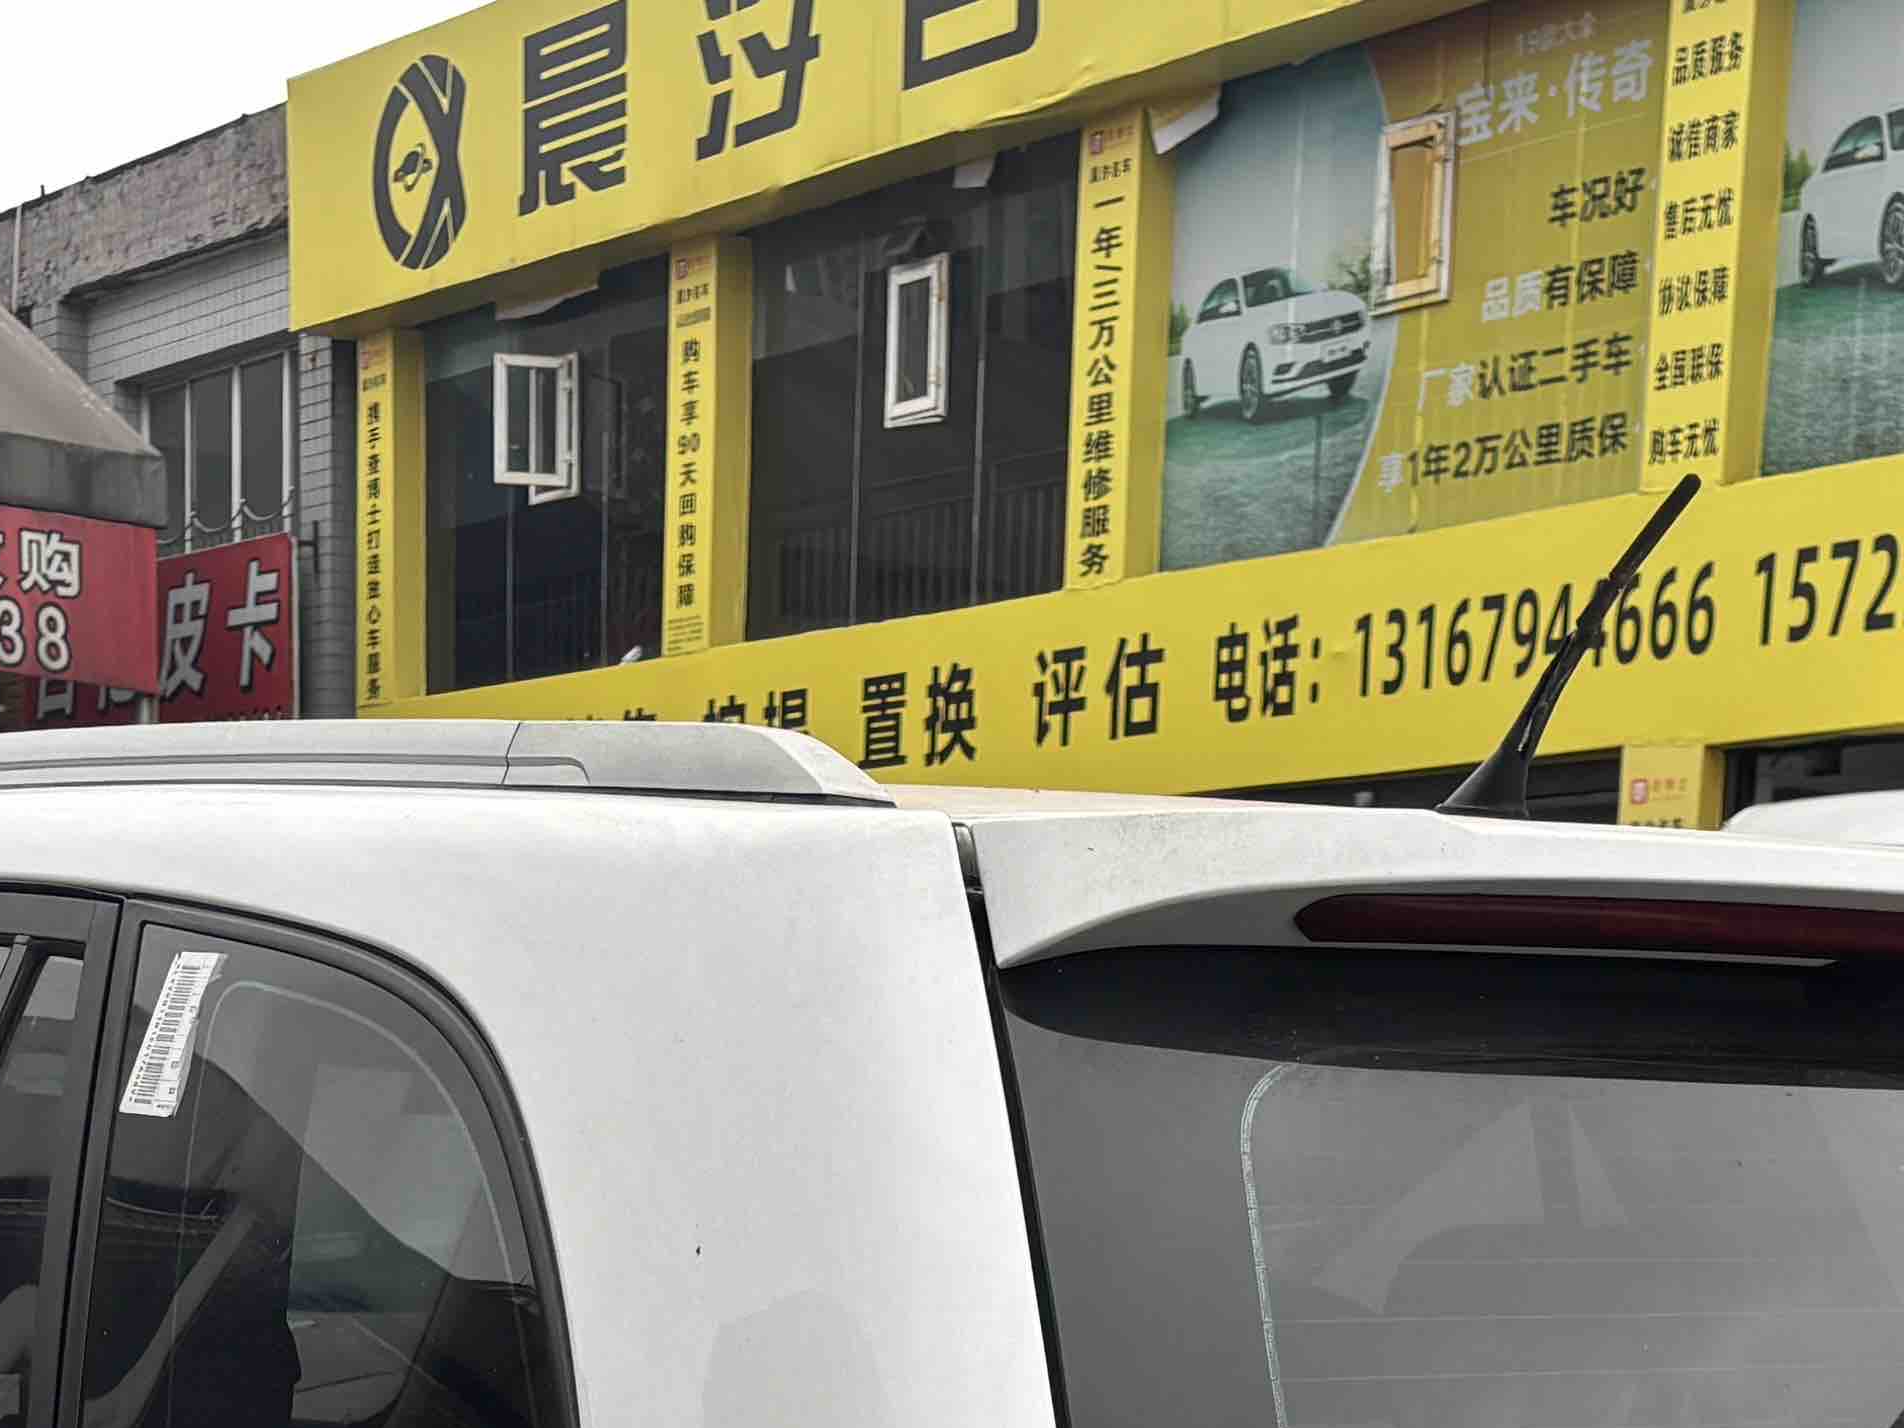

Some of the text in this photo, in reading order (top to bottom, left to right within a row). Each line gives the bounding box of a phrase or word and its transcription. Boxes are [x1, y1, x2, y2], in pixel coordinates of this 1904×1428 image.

[1671, 31, 1745, 87] 品质服务
[1667, 111, 1741, 162] 诚信商家
[1548, 167, 1647, 229] 车况好
[1663, 187, 1735, 240] 售后无忧
[1480, 250, 1639, 324] 品质有保障
[1076, 195, 1126, 578] 一年/三万公里维修服务
[1418, 333, 1635, 410] 厂家认证二手车
[1377, 411, 1629, 494] 享1年2万公里质保
[859, 662, 977, 771] 置换
[1033, 632, 1165, 748] 评估
